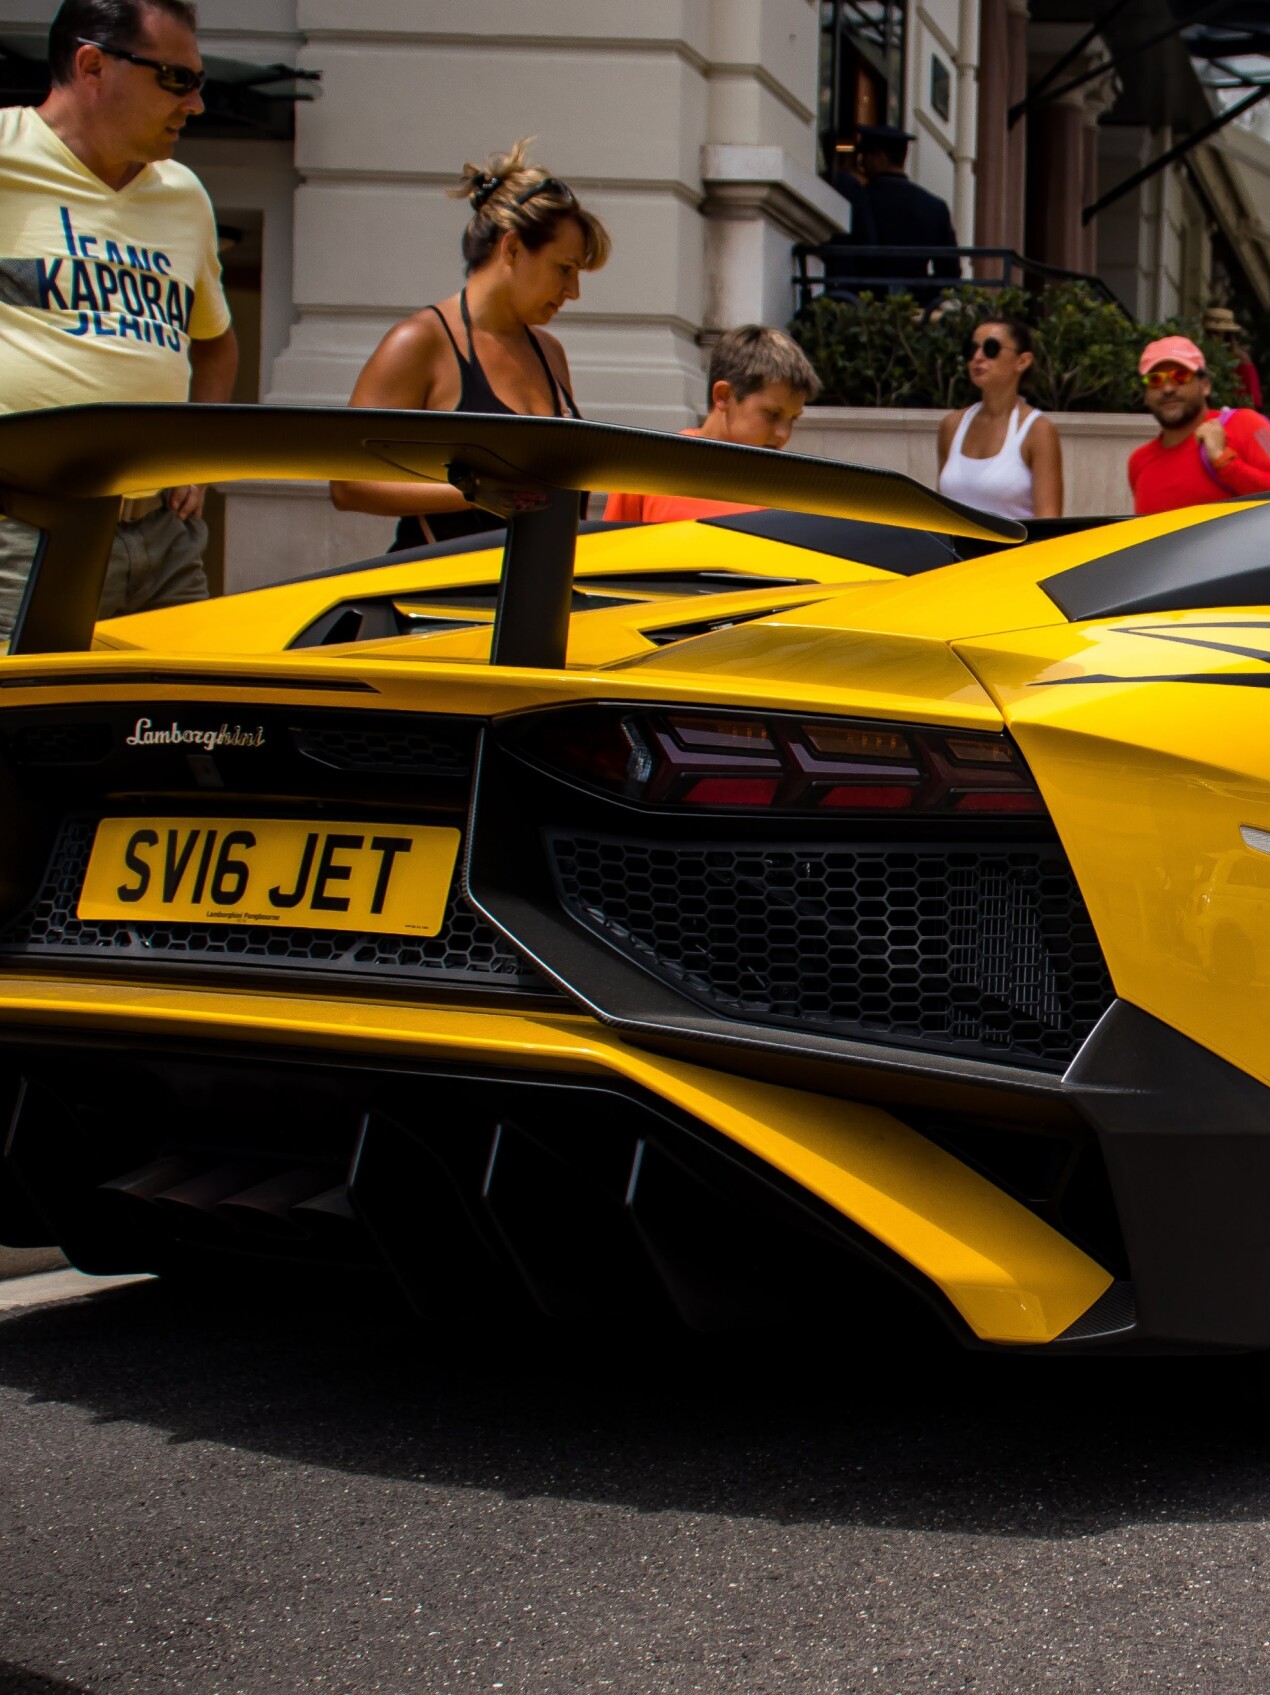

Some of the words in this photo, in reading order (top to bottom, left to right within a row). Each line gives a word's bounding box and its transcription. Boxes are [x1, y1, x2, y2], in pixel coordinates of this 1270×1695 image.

[126, 718, 265, 750] Lamborghini
[117, 829, 257, 905] SV16
[268, 832, 413, 914] JET
